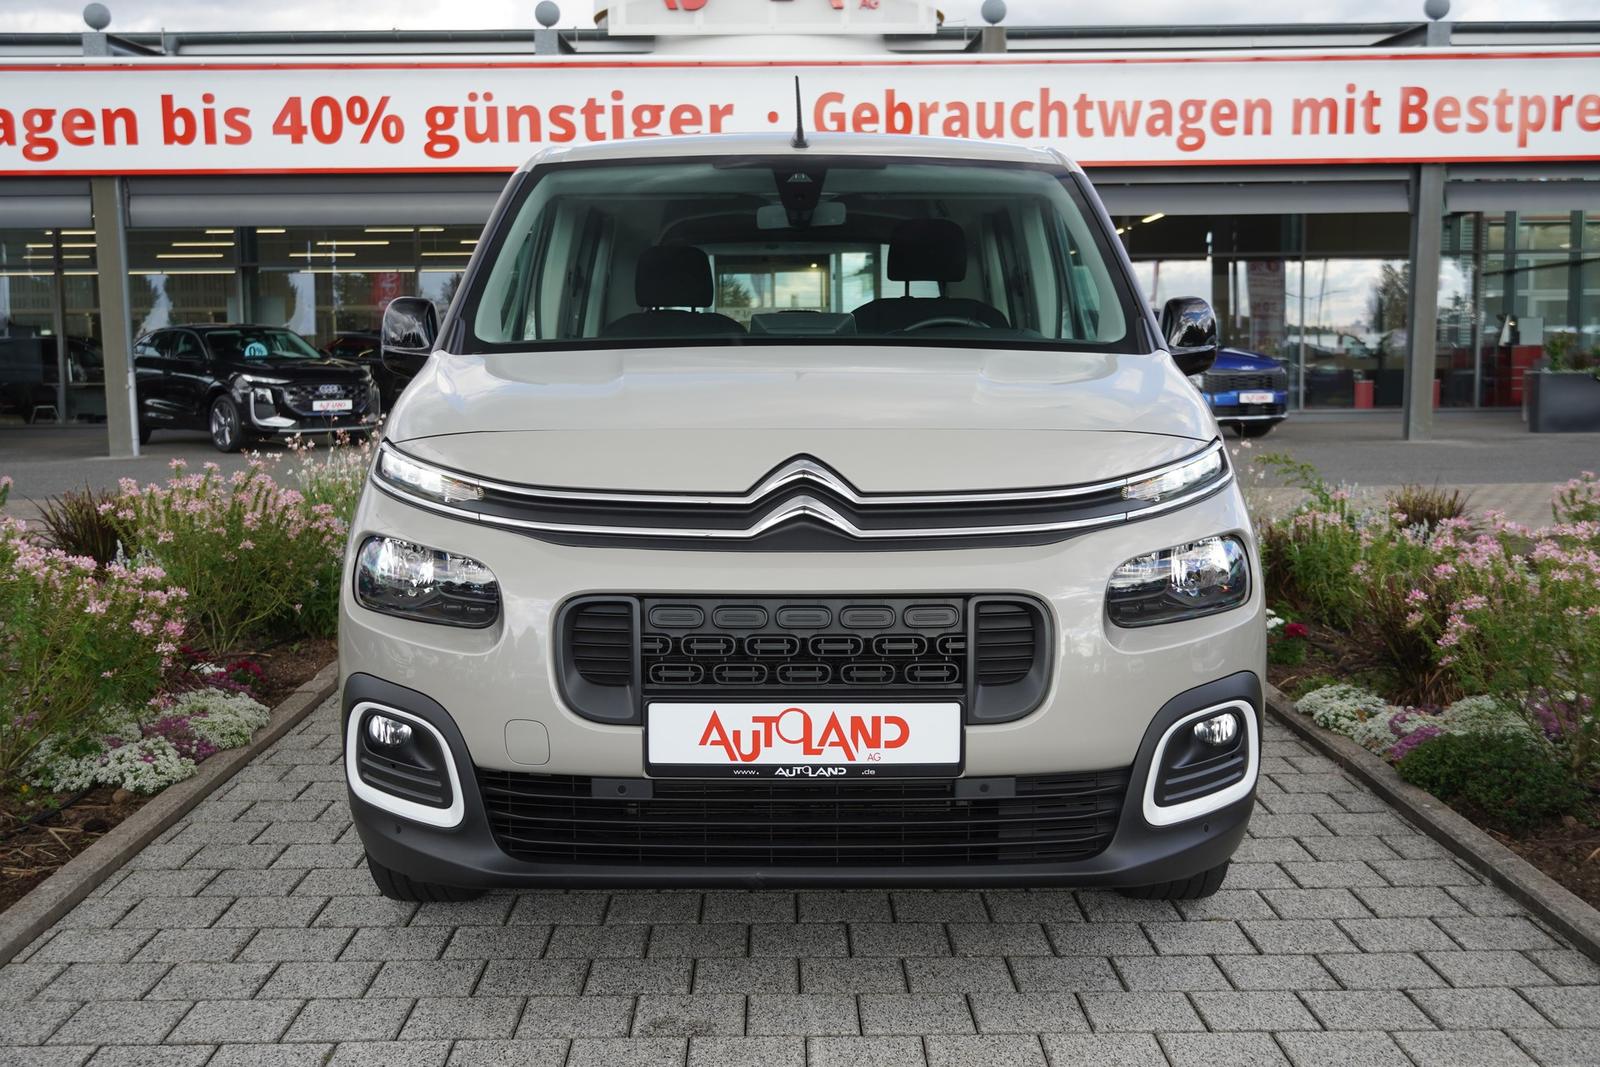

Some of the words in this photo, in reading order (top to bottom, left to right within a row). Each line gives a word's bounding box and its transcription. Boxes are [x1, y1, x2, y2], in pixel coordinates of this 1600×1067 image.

[161, 92, 253, 146] bis
[272, 95, 405, 145] 40%
[423, 90, 734, 158] günstiger
[813, 87, 1273, 152] Gebrauchtwagen
[1292, 83, 1382, 136] mit
[1398, 86, 1600, 148] Bestpre
[698, 707, 911, 763] AUTOLAND
[774, 765, 847, 777] AUTOLAND
[866, 752, 882, 762] AG
